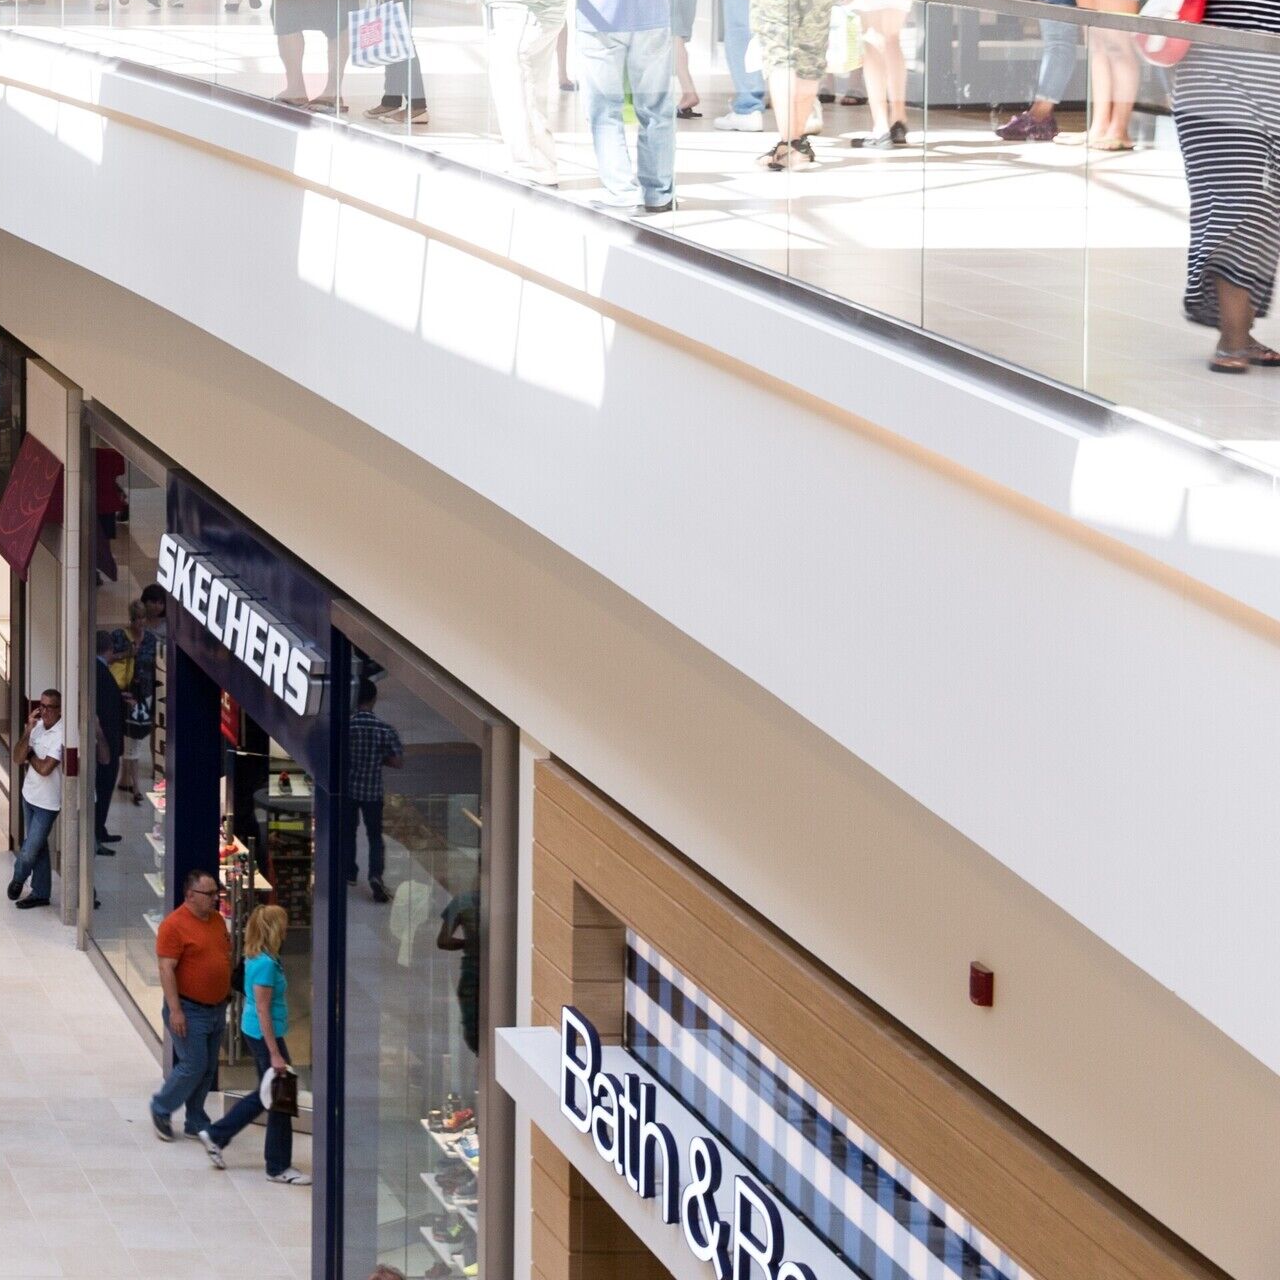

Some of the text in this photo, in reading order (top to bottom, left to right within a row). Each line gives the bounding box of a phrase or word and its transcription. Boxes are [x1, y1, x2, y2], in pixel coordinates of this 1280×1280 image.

[156, 533, 312, 717] SKECHERS
[560, 1005, 680, 1224] Bath
[681, 1136, 731, 1280] &
